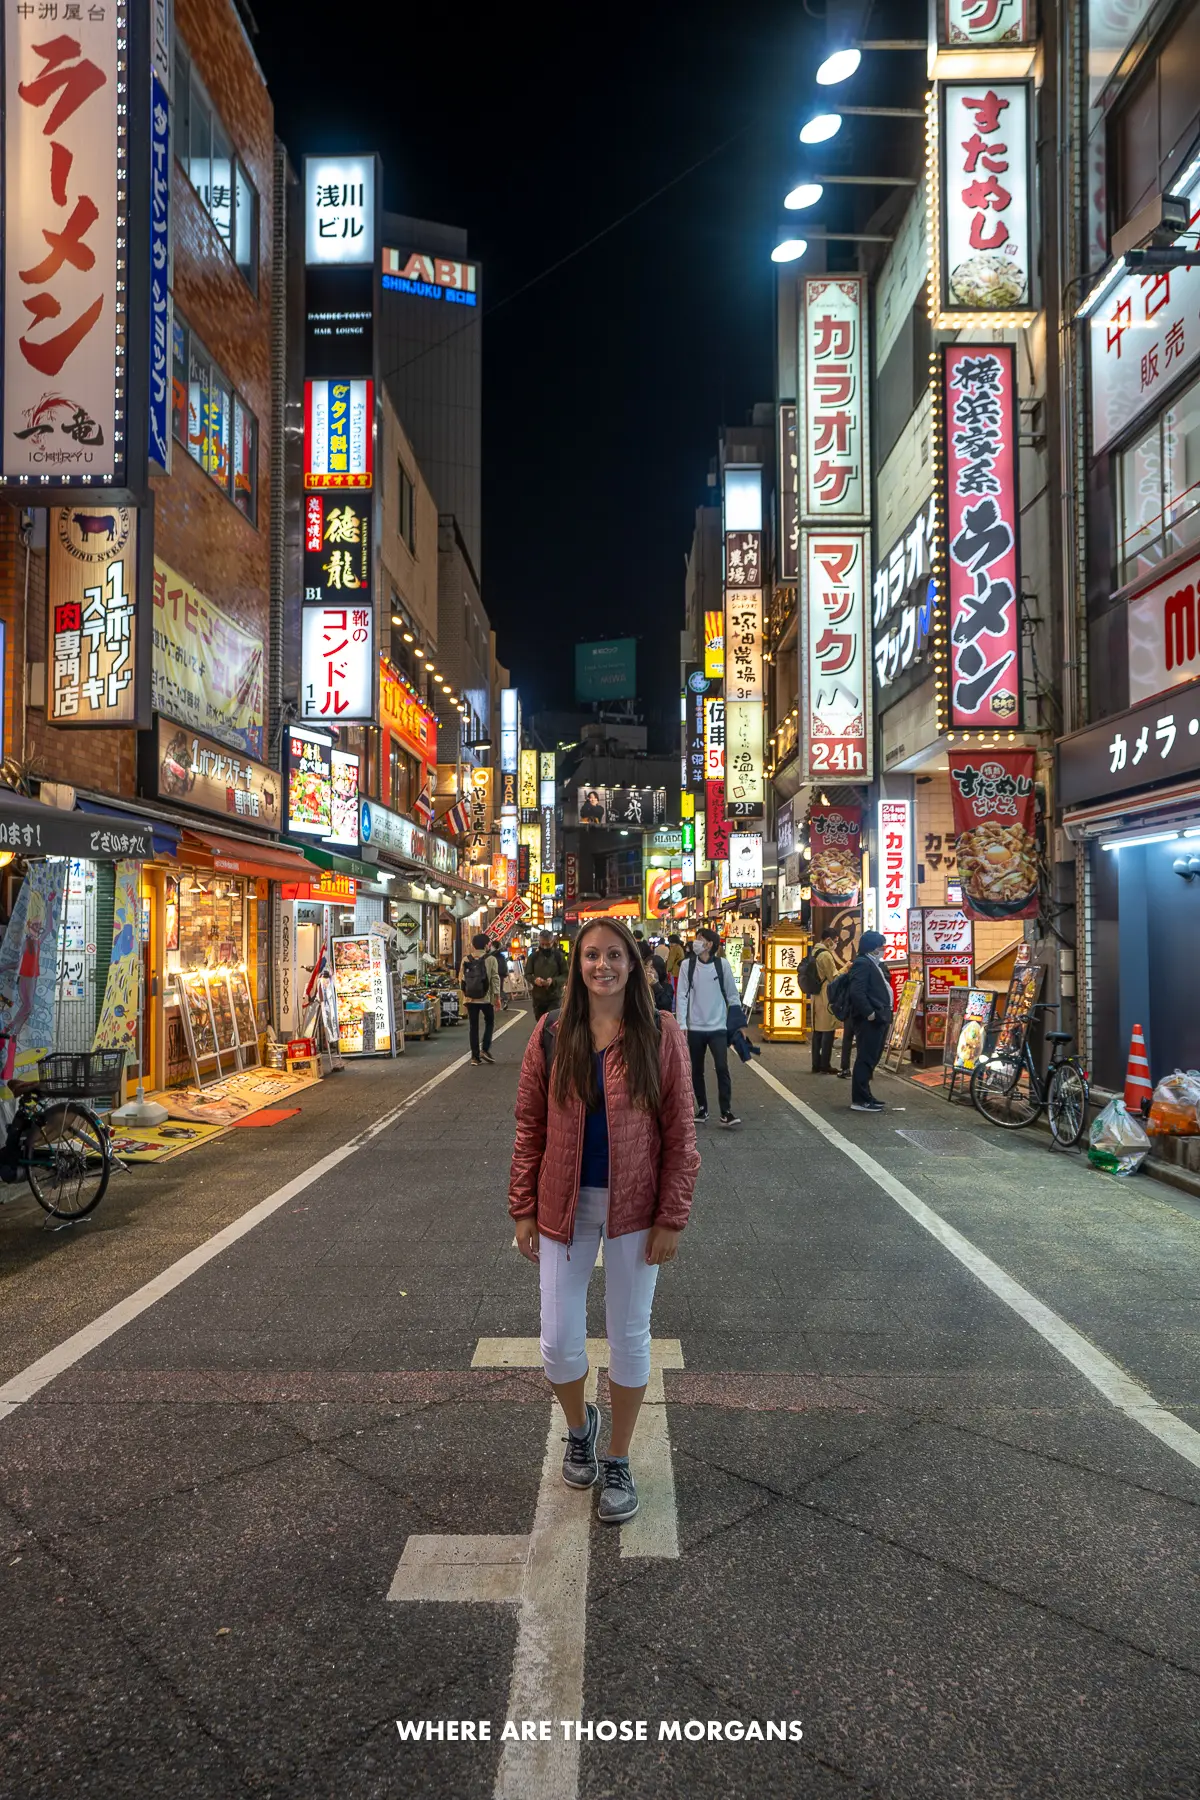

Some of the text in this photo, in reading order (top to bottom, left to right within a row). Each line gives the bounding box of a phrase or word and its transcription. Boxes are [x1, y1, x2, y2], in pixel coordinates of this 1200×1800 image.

[17, 2, 106, 21] 中洲屋台
[18, 35, 107, 376] ラーメン
[316, 183, 364, 207] 浅川
[318, 217, 364, 239] ビル
[382, 247, 476, 292] LABI
[382, 275, 442, 299] SHINJUKU
[336, 327, 364, 335] LOUNGE
[1140, 318, 1185, 393] 販売
[814, 314, 858, 506] カラオケ
[951, 356, 1004, 495] 横浜家系
[331, 401, 347, 471] タイ料理
[29, 452, 94, 463] ICHIRYU
[97, 531, 128, 562] STEAK
[306, 587, 322, 600] B1
[814, 544, 858, 676] マック
[950, 499, 1016, 714] ラーメン
[105, 560, 134, 708] 1ポンド
[352, 609, 369, 643] 靴の
[53, 602, 82, 718] 肉専門店
[82, 586, 106, 710] ステーキ
[320, 610, 350, 716] コンドル
[875, 606, 917, 688] マック
[737, 688, 753, 699] 3F
[812, 742, 864, 770] 24h
[226, 786, 259, 818] 肉専門店
[504, 775, 514, 804] BAR
[473, 787, 486, 847] やきとん
[735, 803, 755, 815] 2F
[886, 832, 904, 908] カラオケ
[928, 920, 968, 931] カラオケ
[934, 932, 963, 942] マック
